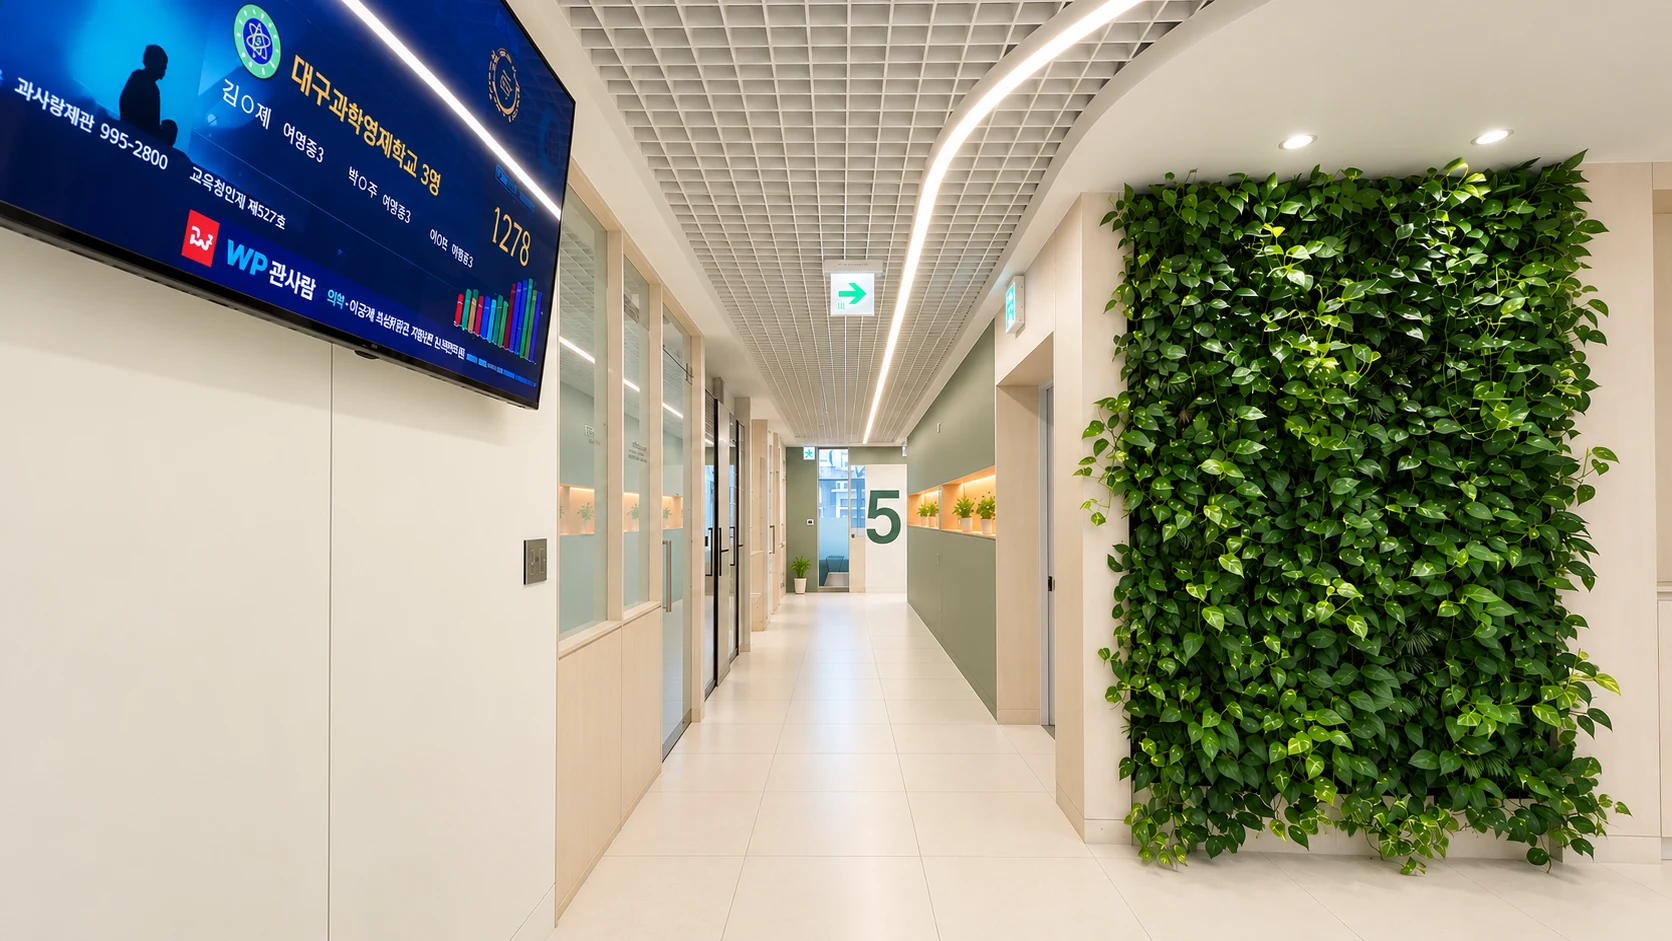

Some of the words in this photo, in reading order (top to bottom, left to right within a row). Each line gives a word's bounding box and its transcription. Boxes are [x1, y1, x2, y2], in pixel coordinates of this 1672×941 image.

[100, 122, 168, 170] 995-2800
[226, 238, 268, 275] WP
[492, 207, 531, 266] 1278
[866, 489, 902, 545] 5
